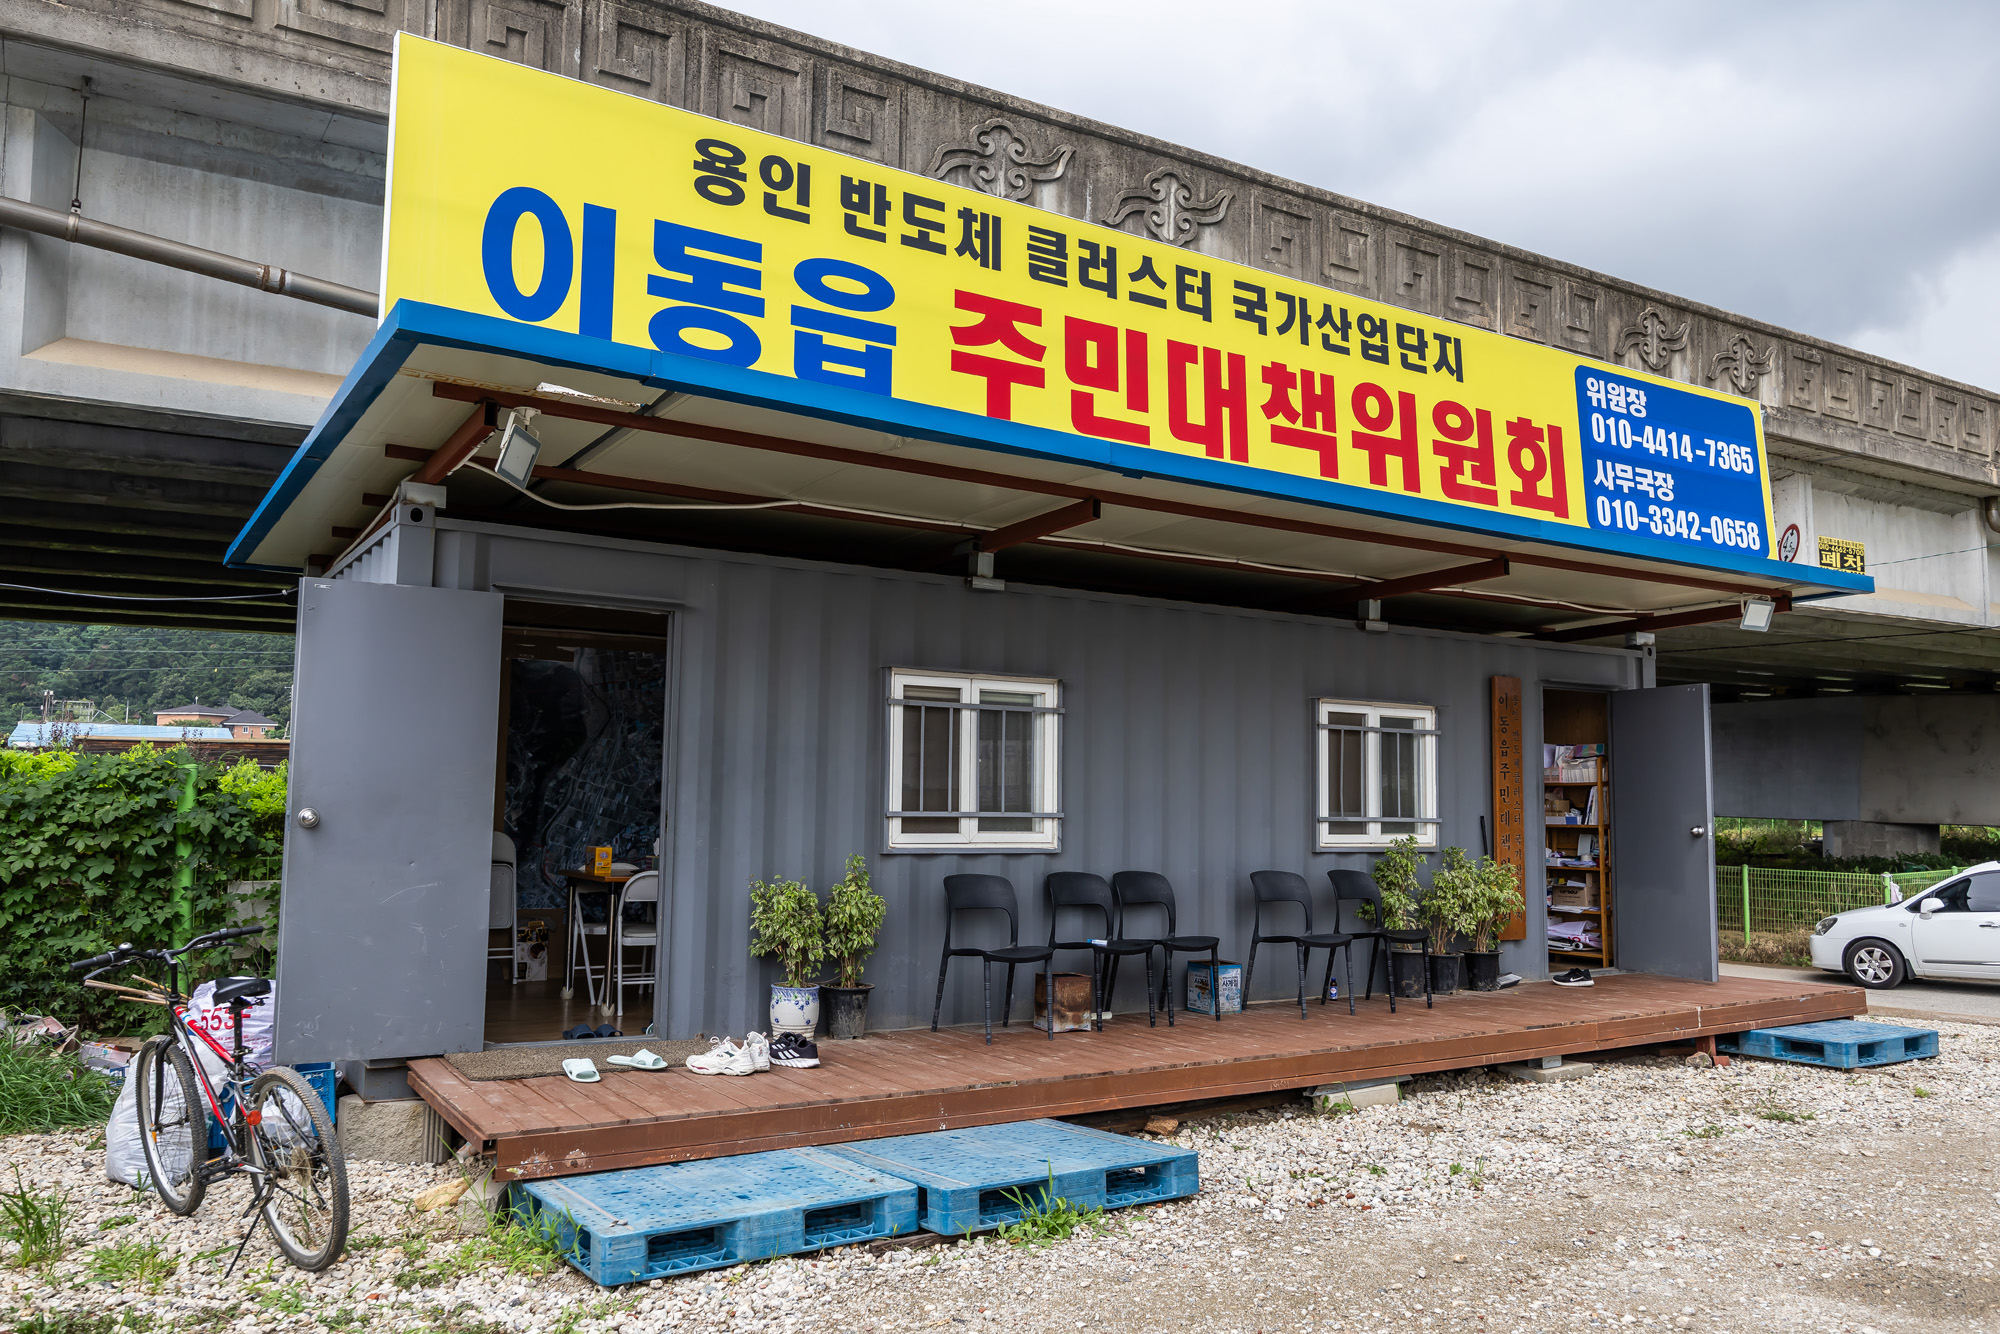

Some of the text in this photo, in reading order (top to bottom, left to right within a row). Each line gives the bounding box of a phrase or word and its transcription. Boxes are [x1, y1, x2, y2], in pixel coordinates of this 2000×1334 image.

[693, 138, 1464, 383] 용인 반도체 클러스터 국가산업단지
[481, 186, 1570, 519] 이동읍 주민대책위원회
[1586, 377, 1647, 418] 위원장
[1591, 412, 1754, 474] 010-4414-7365
[1594, 459, 1675, 502] 사무국장
[1596, 495, 1761, 551] 010-3342-0658
[1514, 834, 1523, 921] 국가산업지
